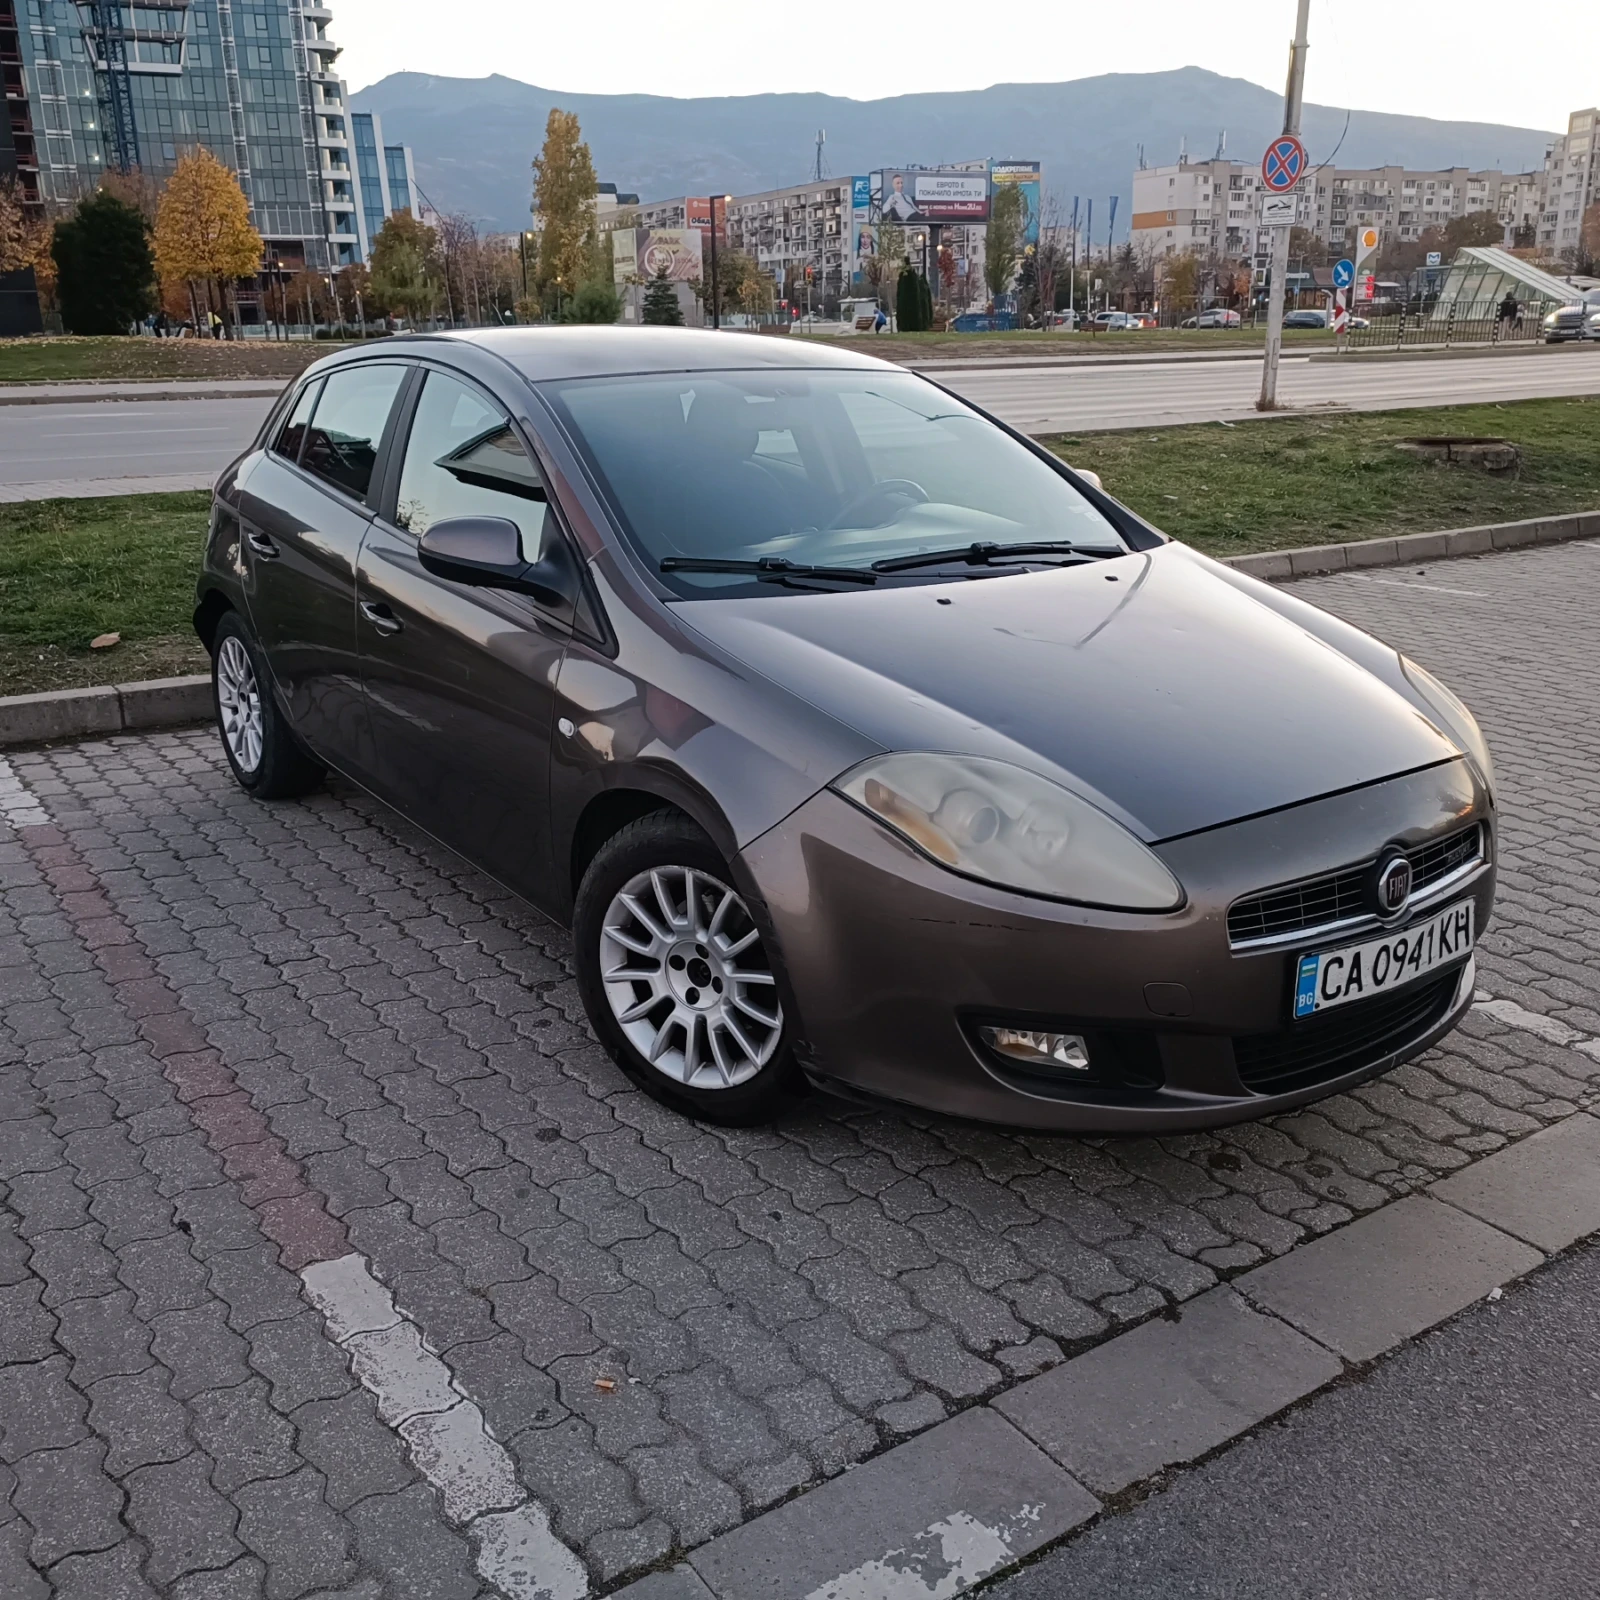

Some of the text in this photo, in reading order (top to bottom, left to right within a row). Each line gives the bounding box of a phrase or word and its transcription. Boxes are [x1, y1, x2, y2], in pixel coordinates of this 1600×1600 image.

[1388, 872, 1408, 901] FIAT
[1320, 951, 1363, 1001] CA
[1298, 992, 1314, 1008] BG
